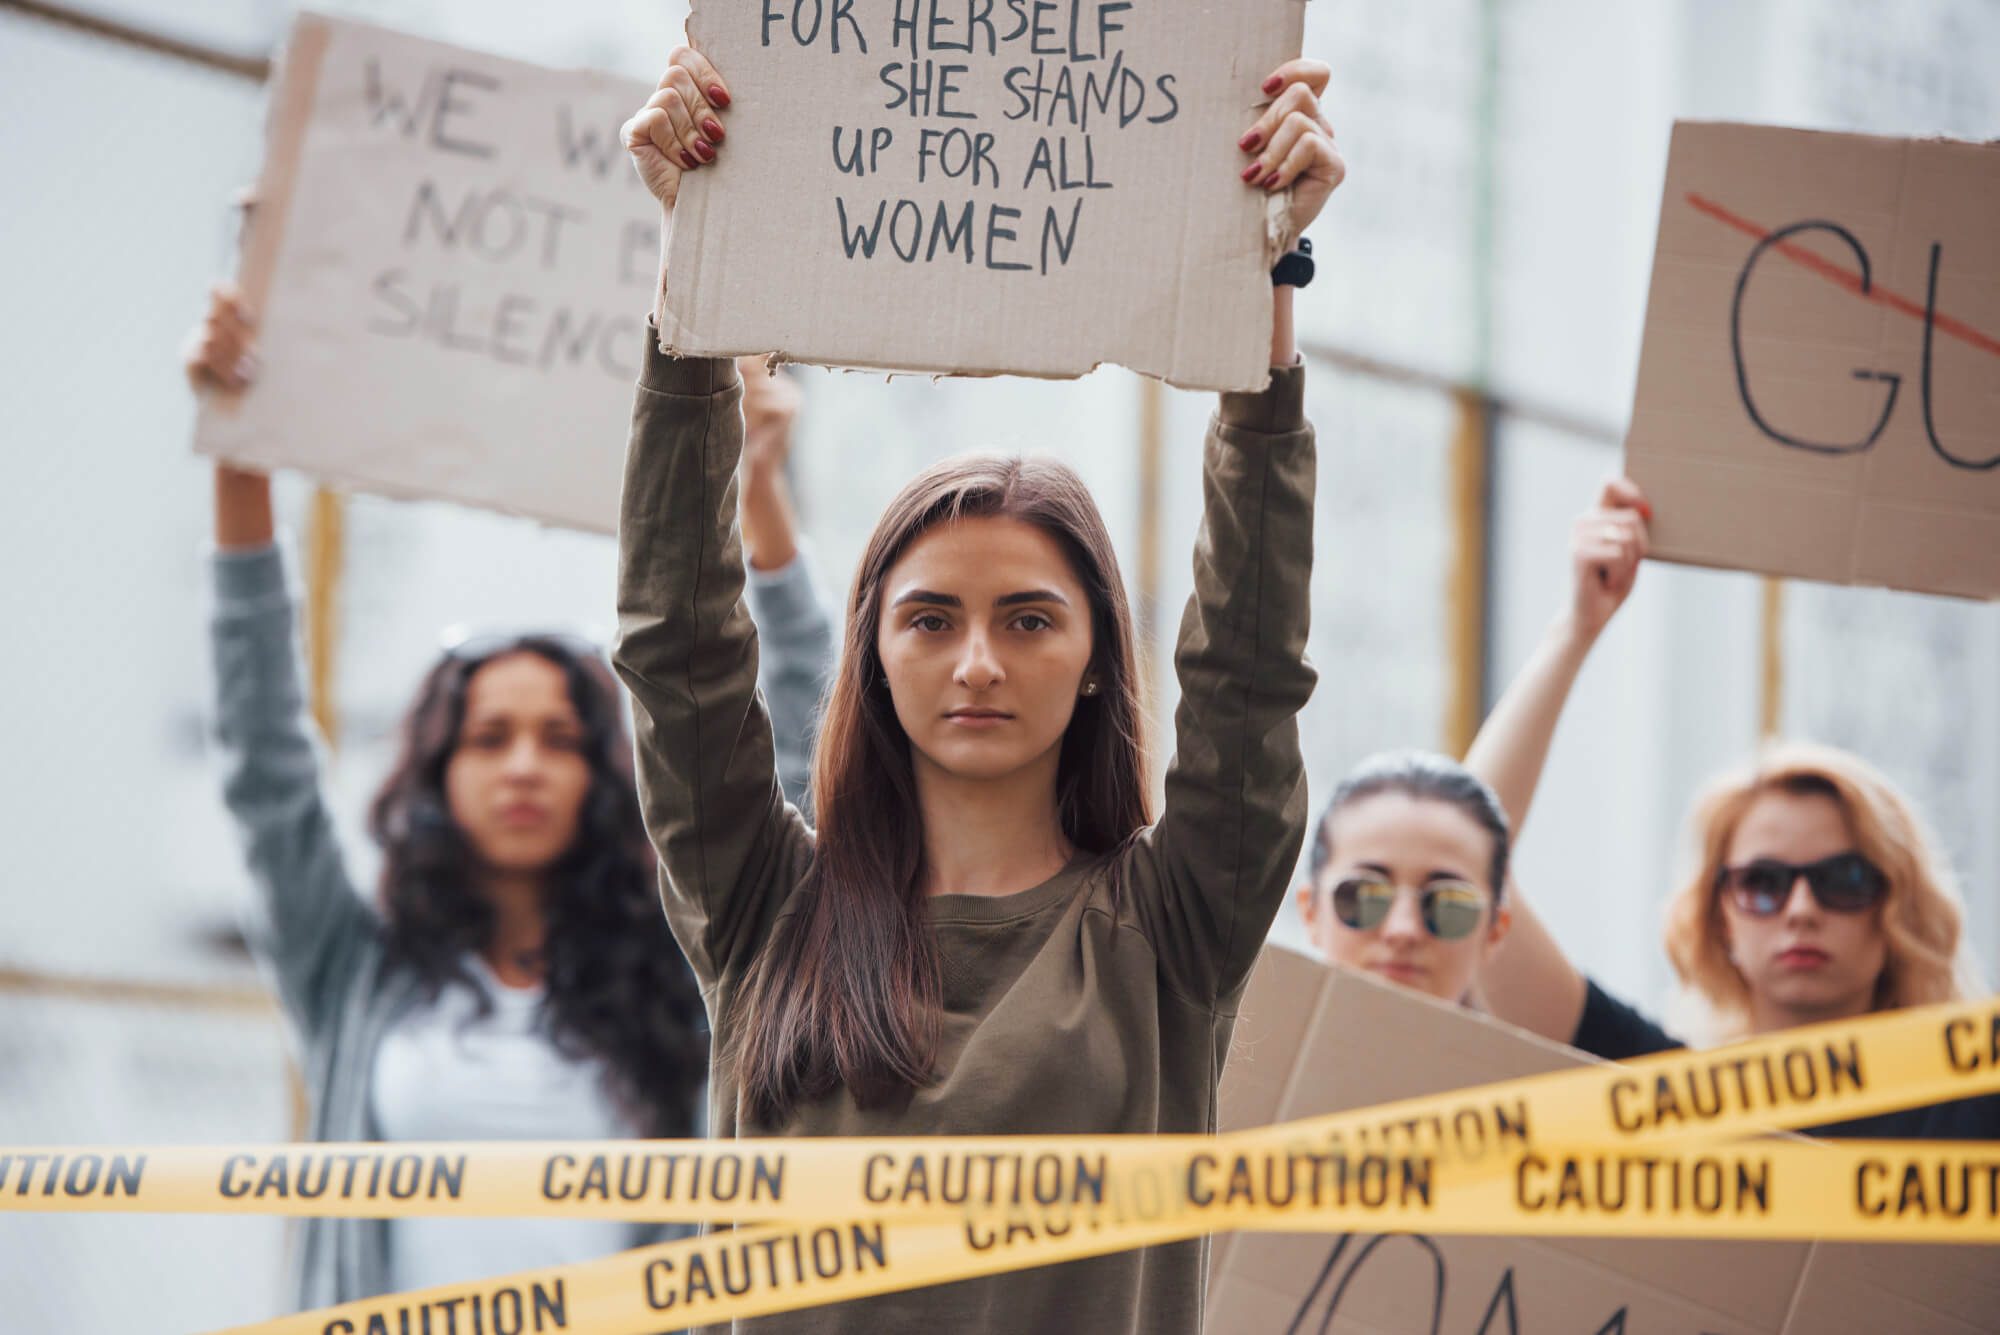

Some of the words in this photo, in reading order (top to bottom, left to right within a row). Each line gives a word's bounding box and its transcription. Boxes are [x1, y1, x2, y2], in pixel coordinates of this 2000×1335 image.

[761, 0, 868, 54] FOR
[892, 0, 1133, 62] HERSELF
[362, 52, 503, 161] WE
[879, 59, 978, 118] SHE
[1002, 50, 1180, 132] STANDS
[832, 126, 893, 177] UP
[917, 127, 1000, 190] FOR
[1022, 136, 1113, 191] ALL
[401, 175, 591, 271] NOT
[835, 197, 1083, 275] WOMEN
[1609, 1036, 1865, 1134] CAUTION
[1945, 1013, 2000, 1074] C
[219, 1153, 467, 1199] CAUTION
[541, 1154, 786, 1201] CAUTION
[862, 1153, 1106, 1205] CAUTION
[1187, 1153, 1433, 1208] CAUTION
[1516, 1156, 1771, 1214] CAUTION
[644, 1222, 888, 1310] CAUTION
